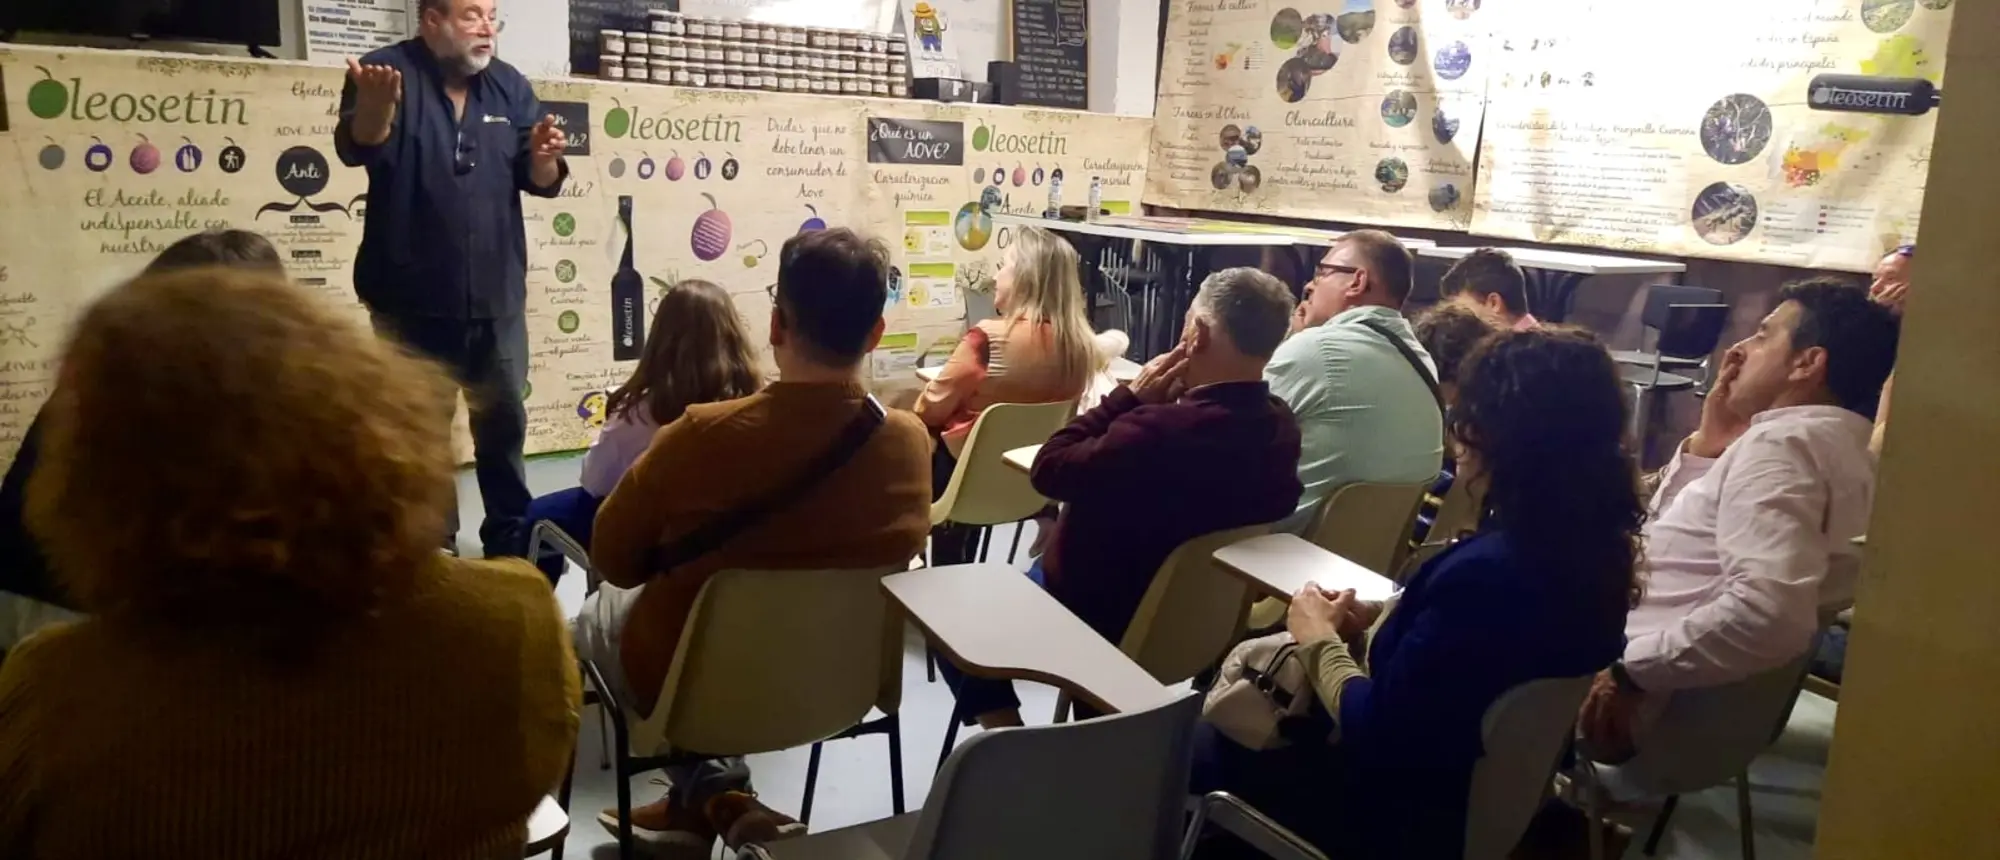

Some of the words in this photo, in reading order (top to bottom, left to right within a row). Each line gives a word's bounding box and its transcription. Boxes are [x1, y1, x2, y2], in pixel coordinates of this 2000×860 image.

[871, 122, 902, 142] ¿Qué
[903, 129, 916, 141] es
[917, 130, 934, 141] un
[902, 141, 950, 160] AOVE?
[284, 162, 321, 180] Anti
[84, 189, 103, 207] El
[177, 189, 231, 207] aliado
[81, 209, 198, 239] indispensable
